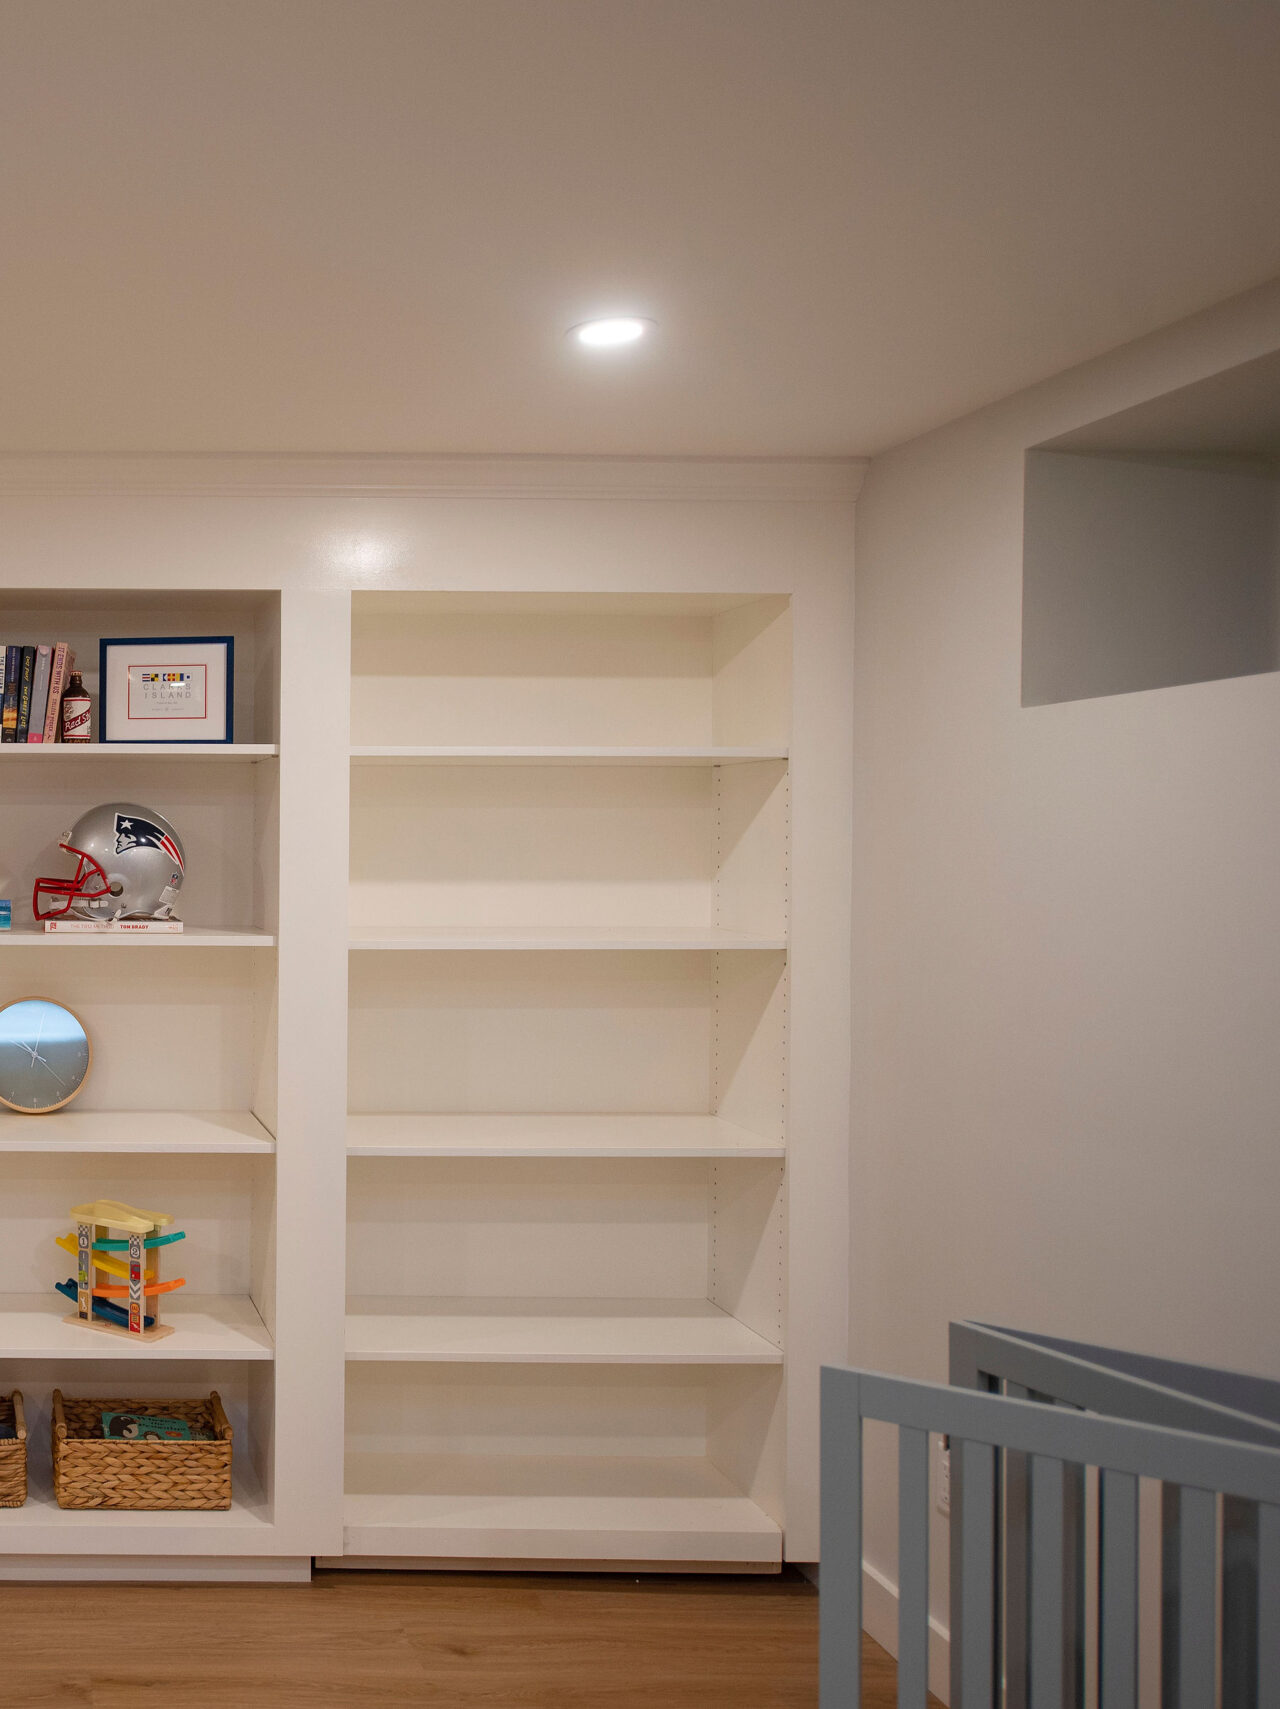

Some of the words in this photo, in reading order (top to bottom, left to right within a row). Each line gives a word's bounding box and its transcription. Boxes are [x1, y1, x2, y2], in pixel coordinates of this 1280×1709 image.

[56, 653, 64, 670] ENDS
[52, 686, 60, 695] US
[65, 716, 81, 732] Red
[132, 1248, 138, 1256] 2
